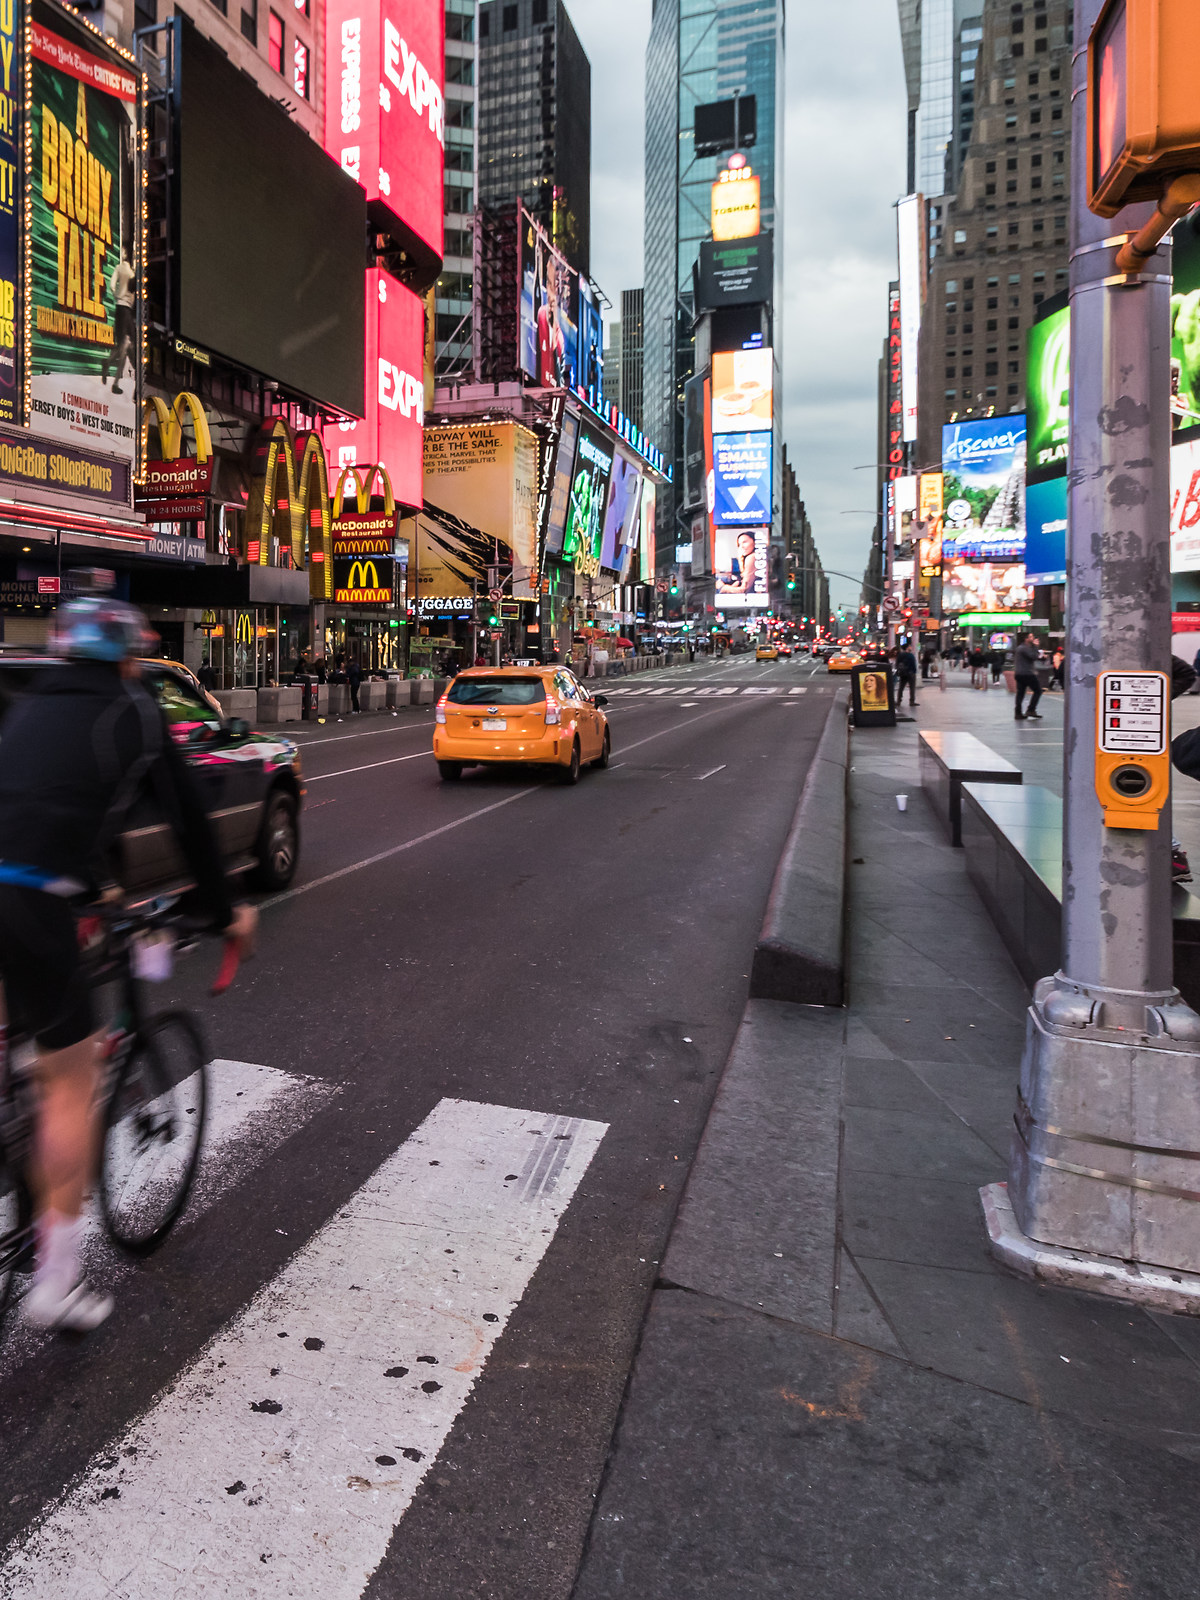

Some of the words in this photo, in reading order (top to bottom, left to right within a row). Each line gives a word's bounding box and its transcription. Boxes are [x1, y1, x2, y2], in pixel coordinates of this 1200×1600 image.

[341, 17, 361, 134] EXPRESS
[384, 17, 445, 152] EXPR
[41, 103, 112, 246] BRONX
[714, 203, 757, 216] TOSHIBA
[53, 209, 107, 319] TALE
[67, 393, 103, 415] COMBINATION
[31, 398, 56, 416] JERSEY
[57, 403, 76, 423] BOYS
[75, 411, 81, 423] &
[81, 412, 100, 429] WEST
[100, 419, 114, 434] SIDE
[469, 429, 495, 439] WILL
[432, 443, 445, 452] BE
[448, 441, 469, 451] THE
[471, 438, 503, 449] SAME.
[617, 411, 664, 473] BROADWAY
[450, 450, 476, 458] MARVEL
[718, 450, 767, 464] SMALL
[451, 457, 497, 466] POSSIBILITIES
[49, 448, 112, 493] SQUAREPANTS
[146, 468, 208, 484] cDonald's
[142, 482, 194, 493] Restaurant
[160, 506, 169, 514] 24
[171, 505, 202, 514] HOURS
[331, 519, 394, 531] McDonald's
[341, 529, 383, 537] Restaurant
[148, 539, 183, 556] MONEY
[187, 544, 205, 559] ATM
[754, 531, 769, 593] FLAGSHIP
[1, 582, 37, 592] MONE
[407, 598, 474, 610] LUGGAGE
